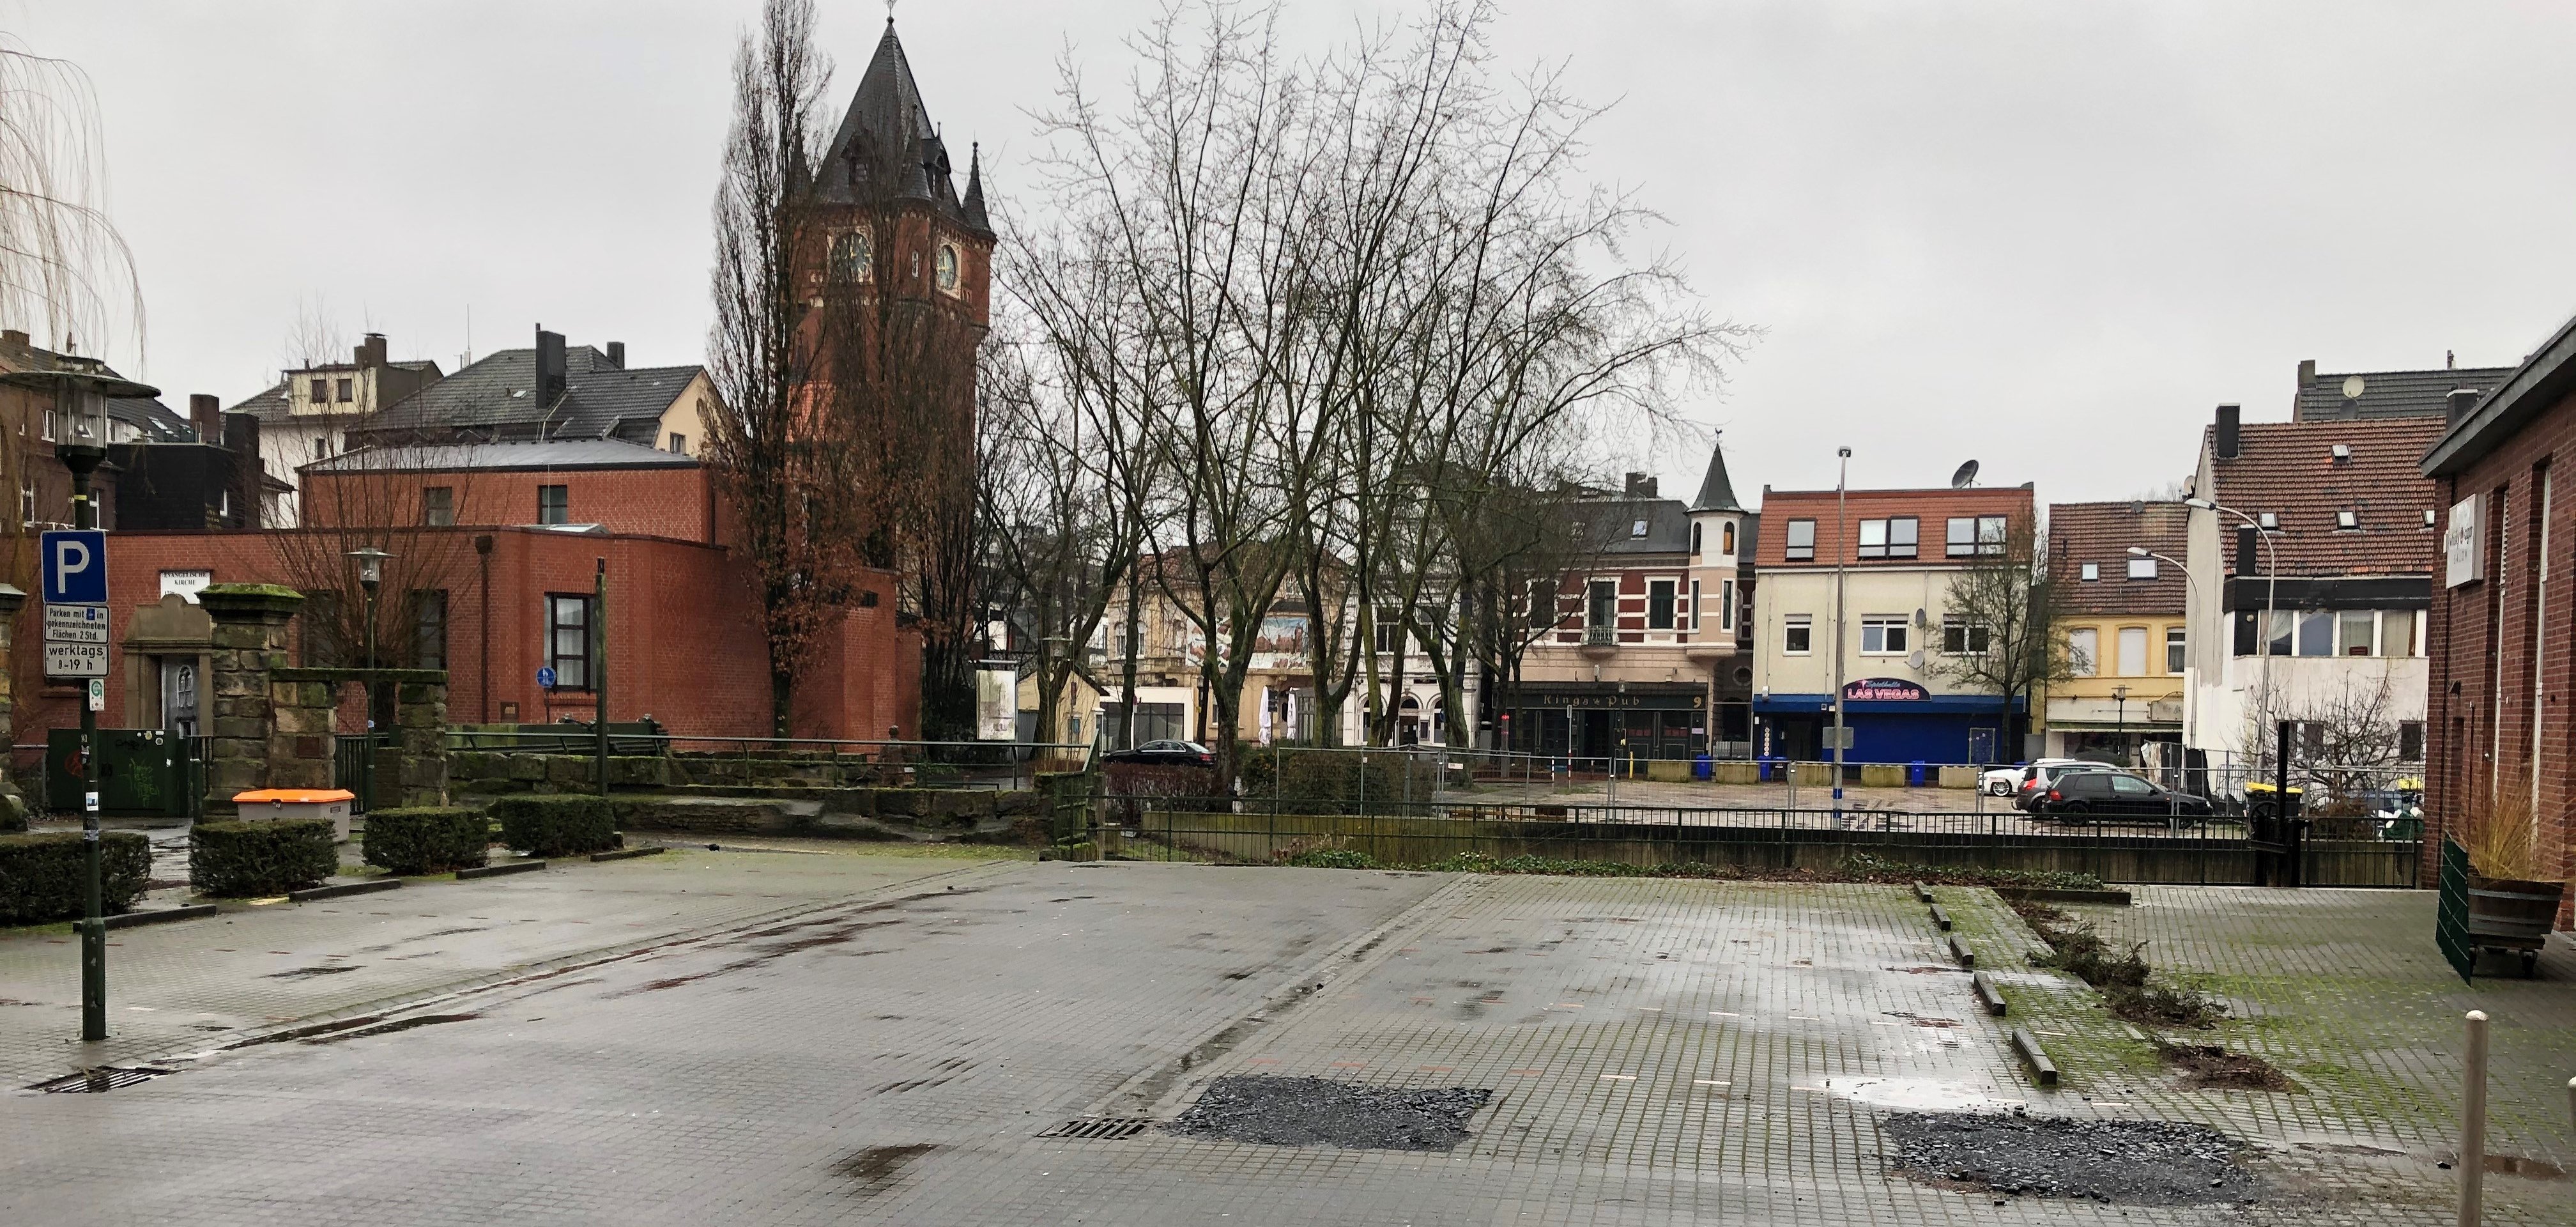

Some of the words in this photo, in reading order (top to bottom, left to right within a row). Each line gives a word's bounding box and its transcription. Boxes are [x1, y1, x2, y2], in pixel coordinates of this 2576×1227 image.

[57, 541, 89, 594] P
[49, 608, 70, 617] Parken
[73, 610, 84, 618] mit
[47, 619, 105, 629] gekennzeichneten
[52, 629, 77, 639] Flächen
[49, 644, 103, 658] werktags
[87, 659, 93, 670] h
[1848, 688, 1873, 699] LAS
[1874, 688, 1919, 700] VEGAS
[1605, 695, 1639, 707] Pub
[1693, 696, 1702, 708] 9
